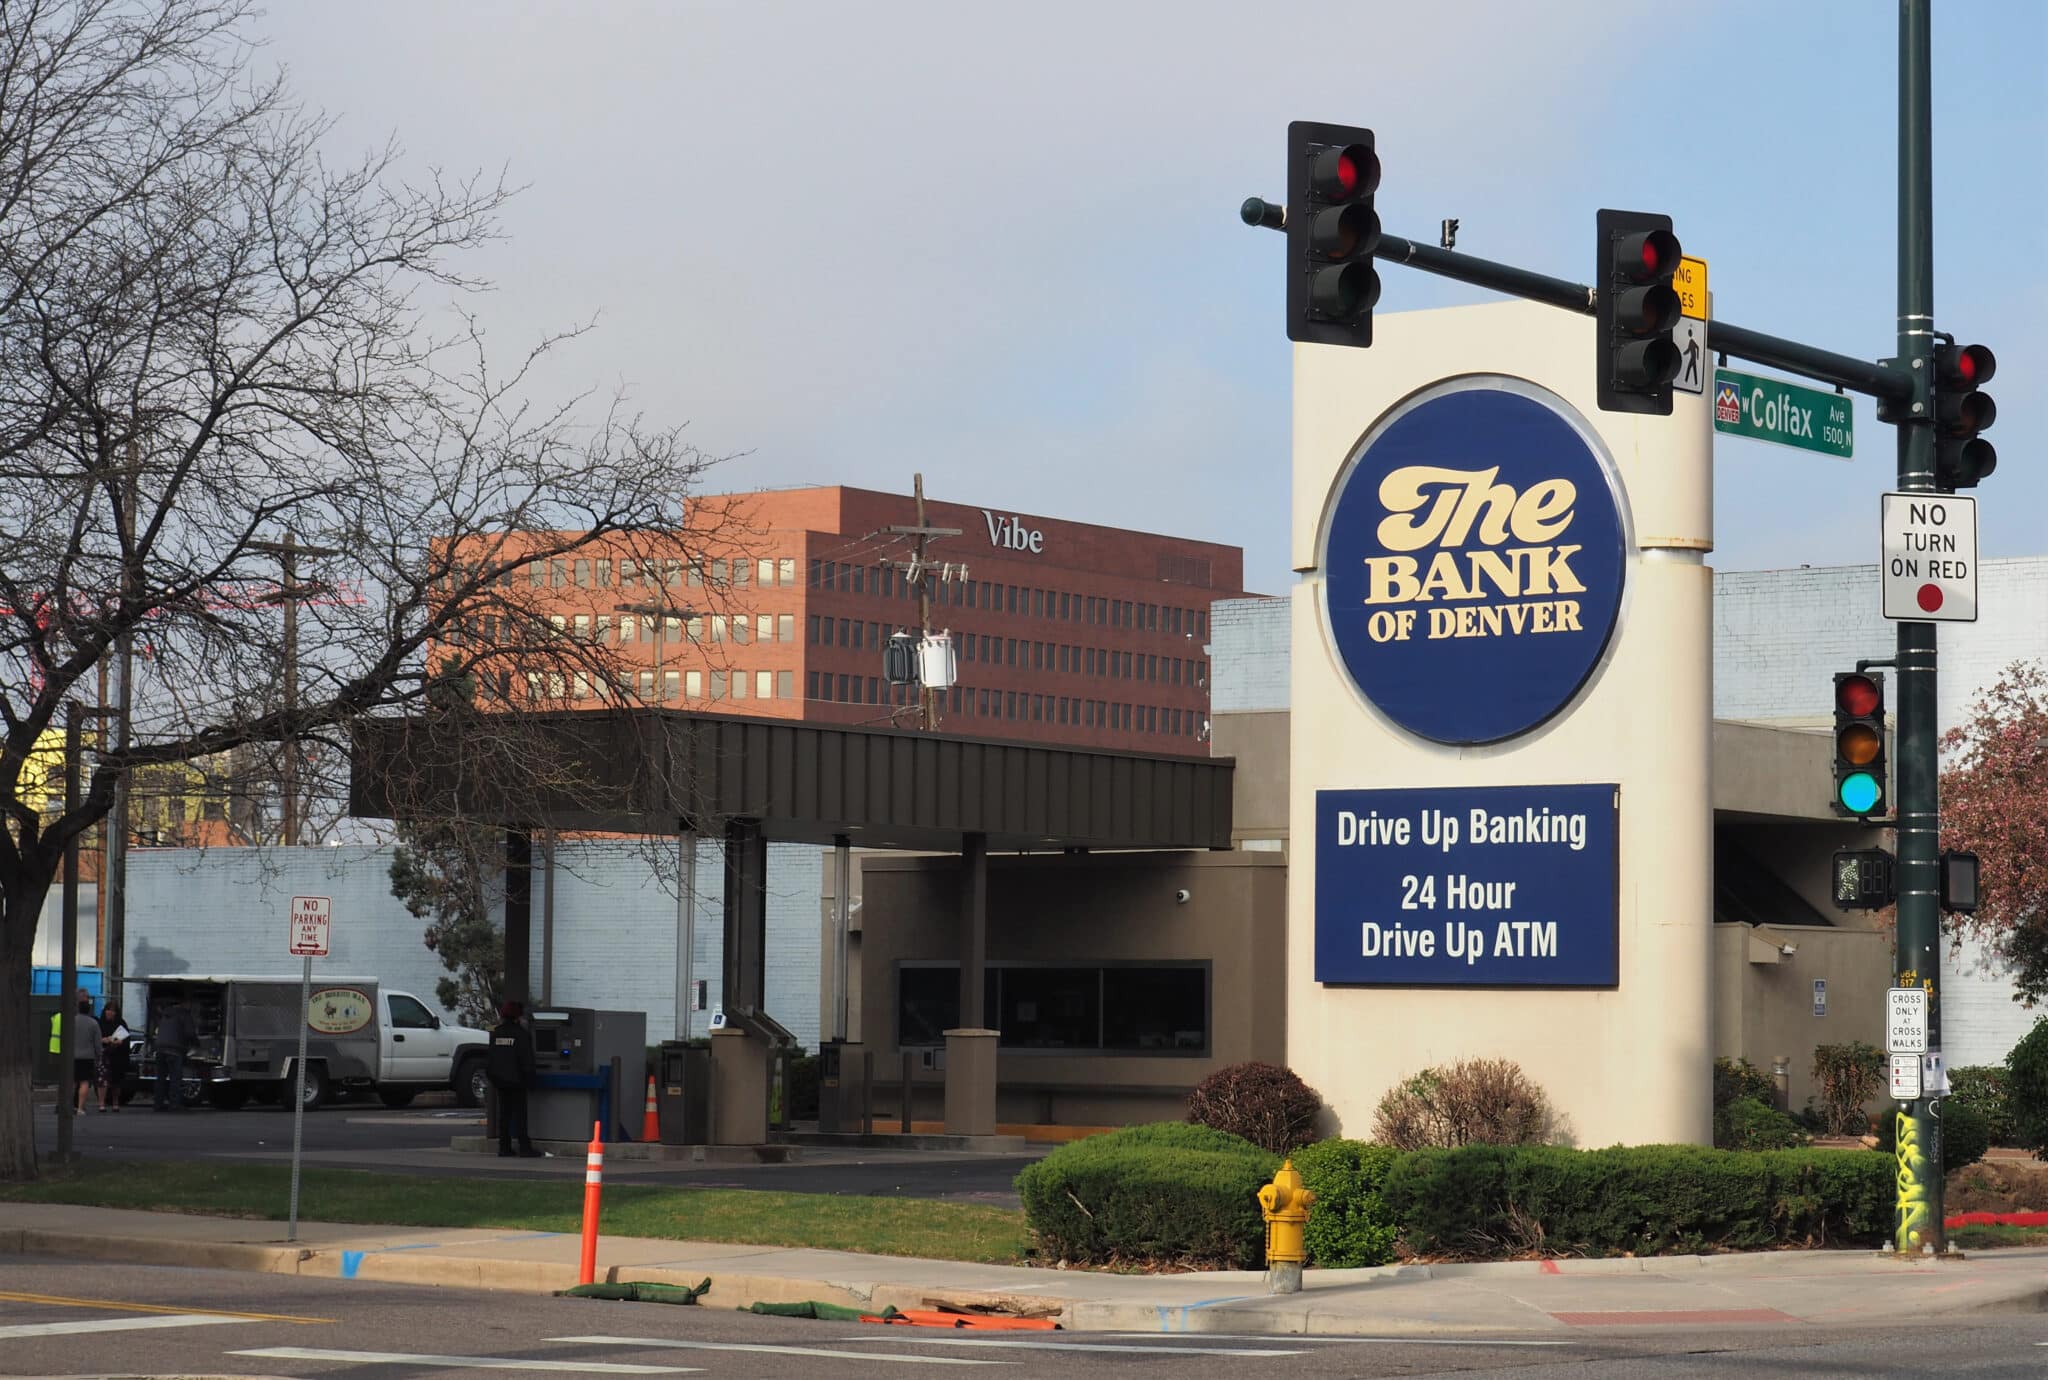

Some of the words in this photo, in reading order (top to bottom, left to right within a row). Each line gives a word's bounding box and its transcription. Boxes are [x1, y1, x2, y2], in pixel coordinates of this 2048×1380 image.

[1673, 267, 1692, 284] ING
[1681, 291, 1695, 309] ES
[1751, 387, 1813, 439] Colfax
[1829, 404, 1845, 424] Ave
[1823, 425, 1843, 445] 1500
[1845, 430, 1852, 447] N
[1377, 465, 1577, 551] The
[1910, 503, 1946, 526] NO
[980, 510, 1043, 553] Vibe
[1903, 532, 1955, 553] TURN
[1364, 544, 1587, 604] BANK
[1891, 558, 1918, 578] ON
[1929, 560, 1967, 579] RED
[1367, 609, 1417, 643] OF
[1427, 600, 1583, 640] DENVER
[1337, 811, 1411, 846] Drive
[1421, 809, 1459, 852] Up
[1469, 807, 1586, 850] Banking
[1401, 875, 1437, 910] 24
[1447, 874, 1516, 910] Hour
[303, 900, 319, 911] NO
[294, 913, 328, 925] PARKING
[302, 925, 317, 933] ANY
[300, 933, 319, 942] TIME
[1362, 921, 1435, 957] Drive
[1446, 921, 1484, 965] Up
[1493, 921, 1557, 957] ATM
[1892, 994, 1921, 1004] CROSS
[1895, 1007, 1918, 1016] ONLY
[1892, 1027, 1922, 1036] CROSS
[1892, 1039, 1922, 1048] WALKS
